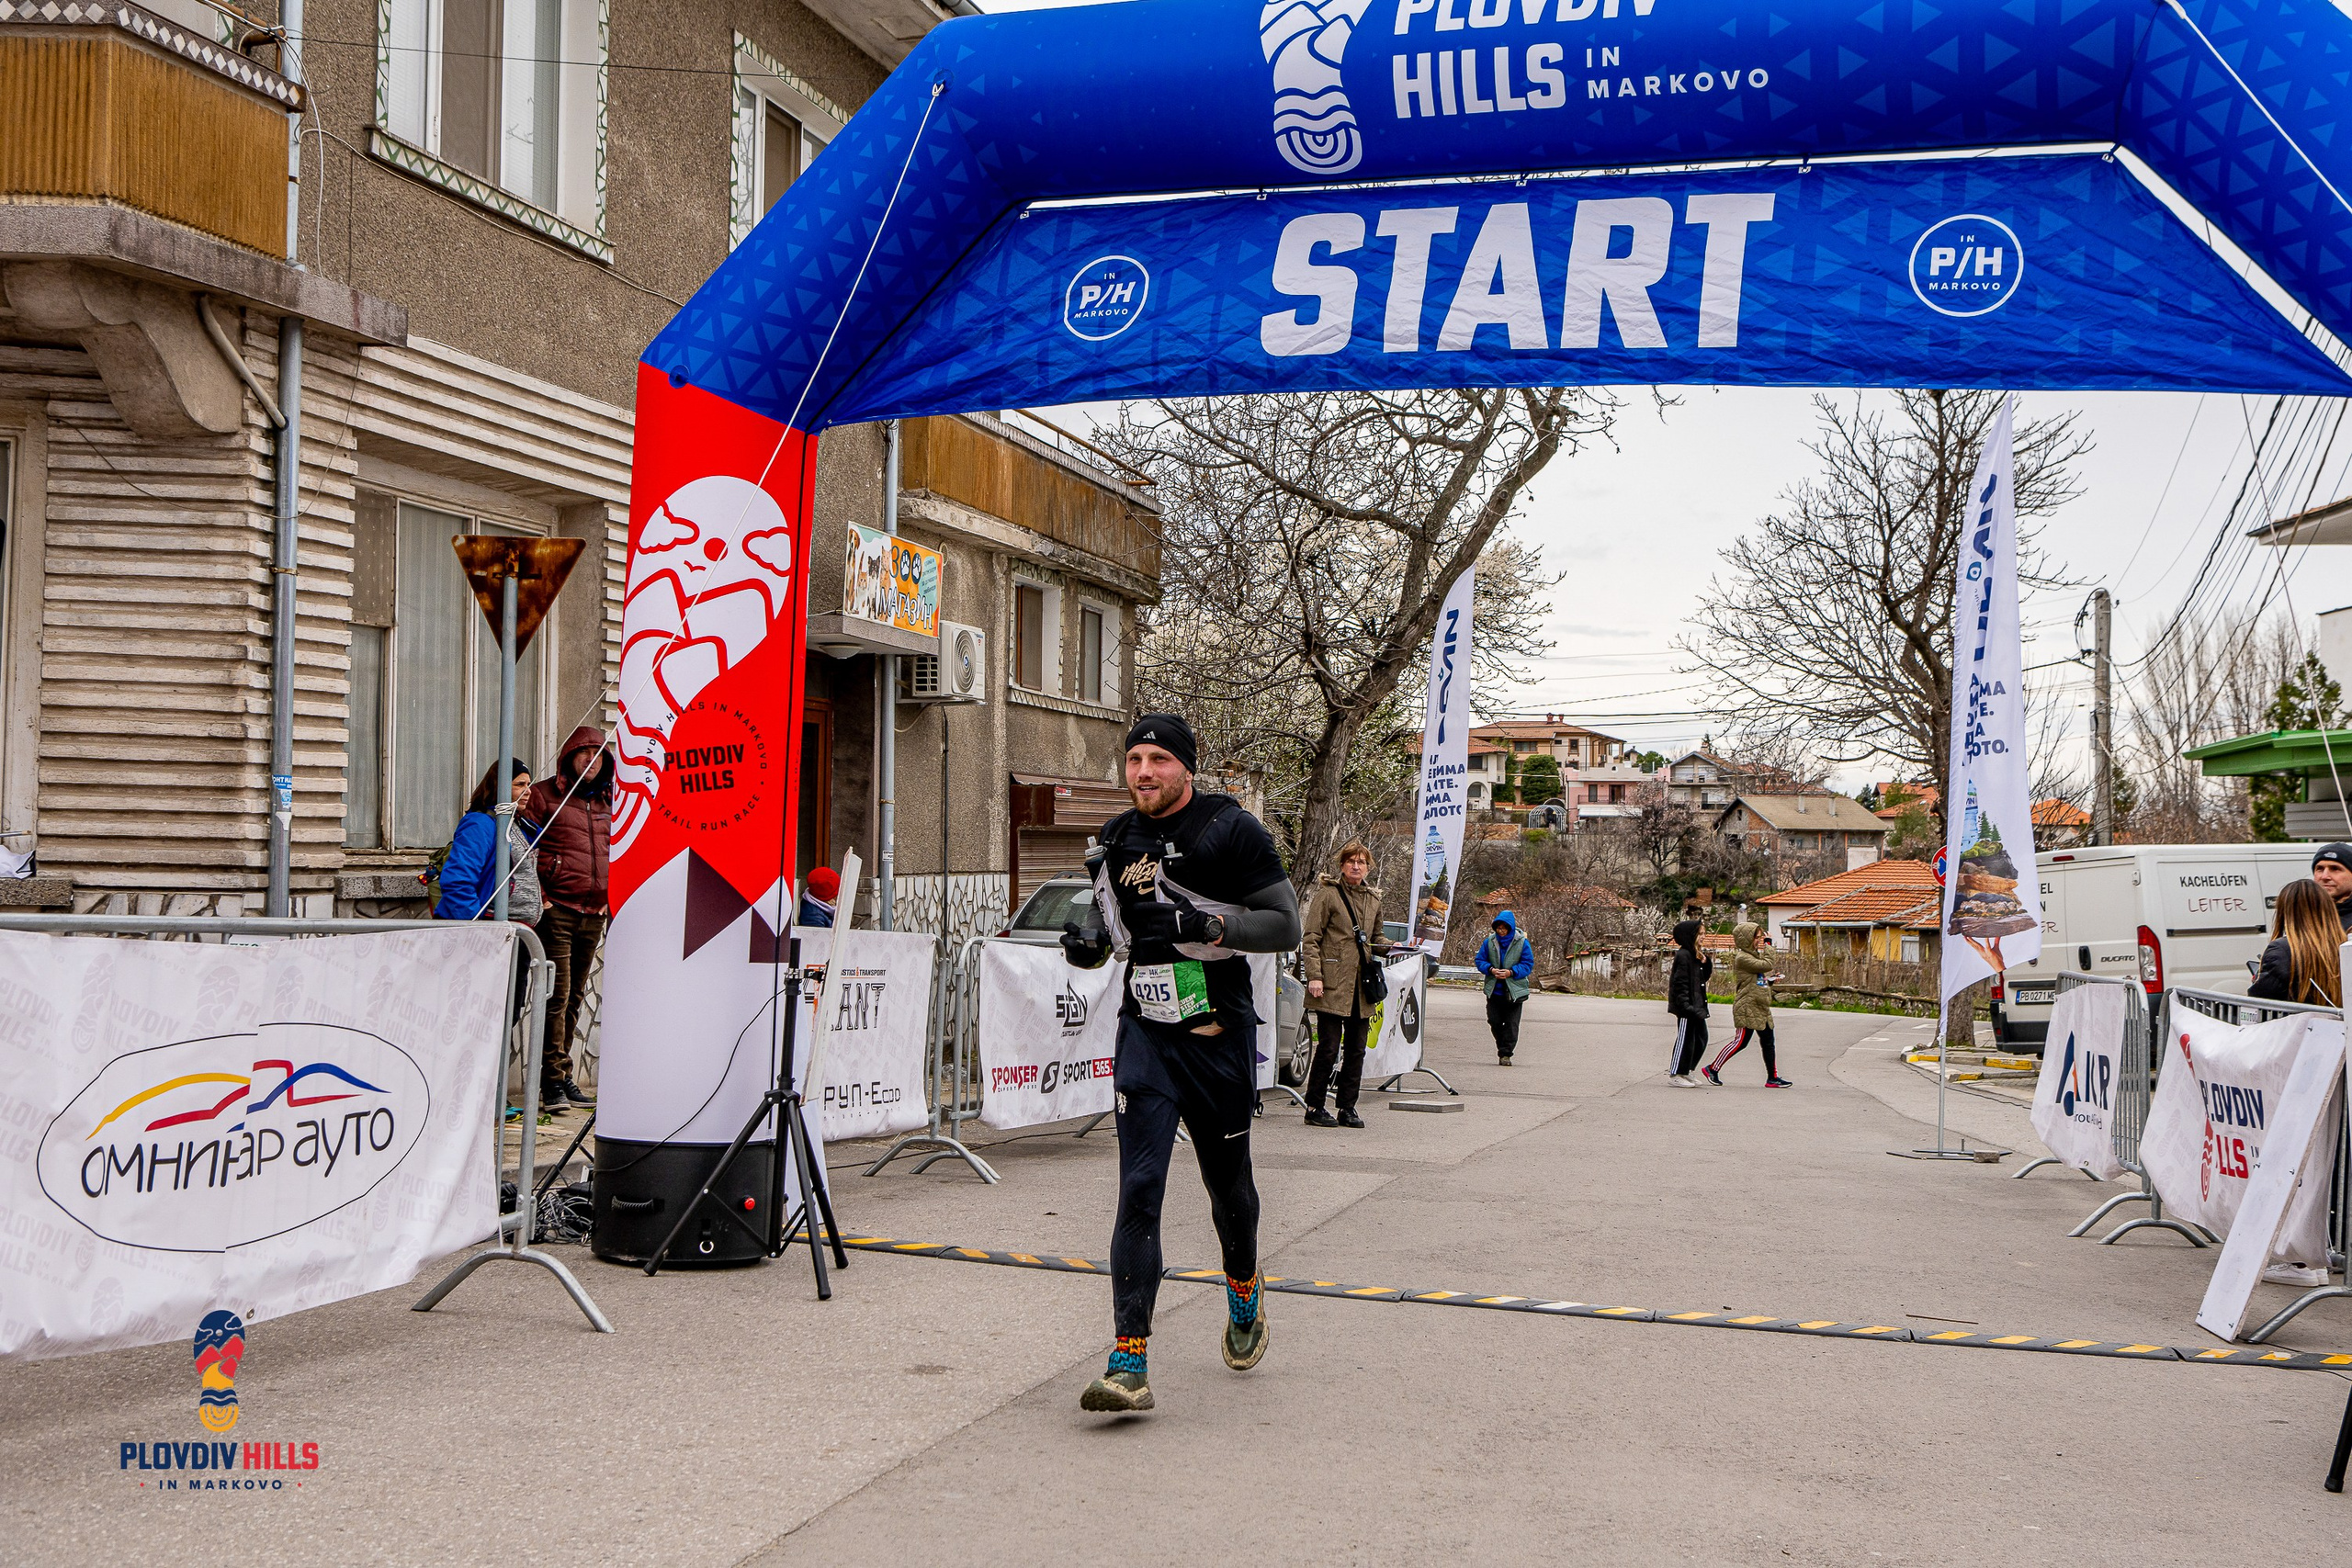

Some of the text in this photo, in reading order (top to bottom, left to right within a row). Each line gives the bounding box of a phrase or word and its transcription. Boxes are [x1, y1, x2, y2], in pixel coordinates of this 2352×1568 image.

[1587, 46, 1620, 68] IN
[1393, 42, 1566, 118] HILLS
[1587, 68, 1770, 99] MARKOVO
[1960, 234, 1975, 243] IN
[1261, 191, 1775, 357] START
[1929, 246, 2003, 279] P/H
[1103, 272, 1115, 280] IN
[1928, 282, 2001, 291] MARKOVO
[1079, 281, 1136, 310] P/H
[1073, 308, 1128, 319] MARKOVO
[879, 586, 933, 630] МАГАЗИН
[644, 723, 664, 784] PLOVDIV
[666, 700, 706, 723] HILLS
[713, 701, 728, 713] IN
[734, 710, 768, 770] MARKOVO
[663, 743, 745, 772] PLOVDIV
[680, 769, 735, 795] HILLS
[657, 794, 761, 831] TRAIL RUN RACE
[2188, 897, 2248, 913] LEITER
[2100, 954, 2136, 963] DUCATO
[859, 968, 887, 976] TRANSPORT
[1136, 982, 1171, 1003] 4215
[2019, 991, 2030, 1001] PB
[2030, 991, 2046, 1001] 0271
[830, 982, 887, 1032] ANT
[991, 1065, 1039, 1093] SPONSER
[1063, 1059, 1092, 1085] SPORT
